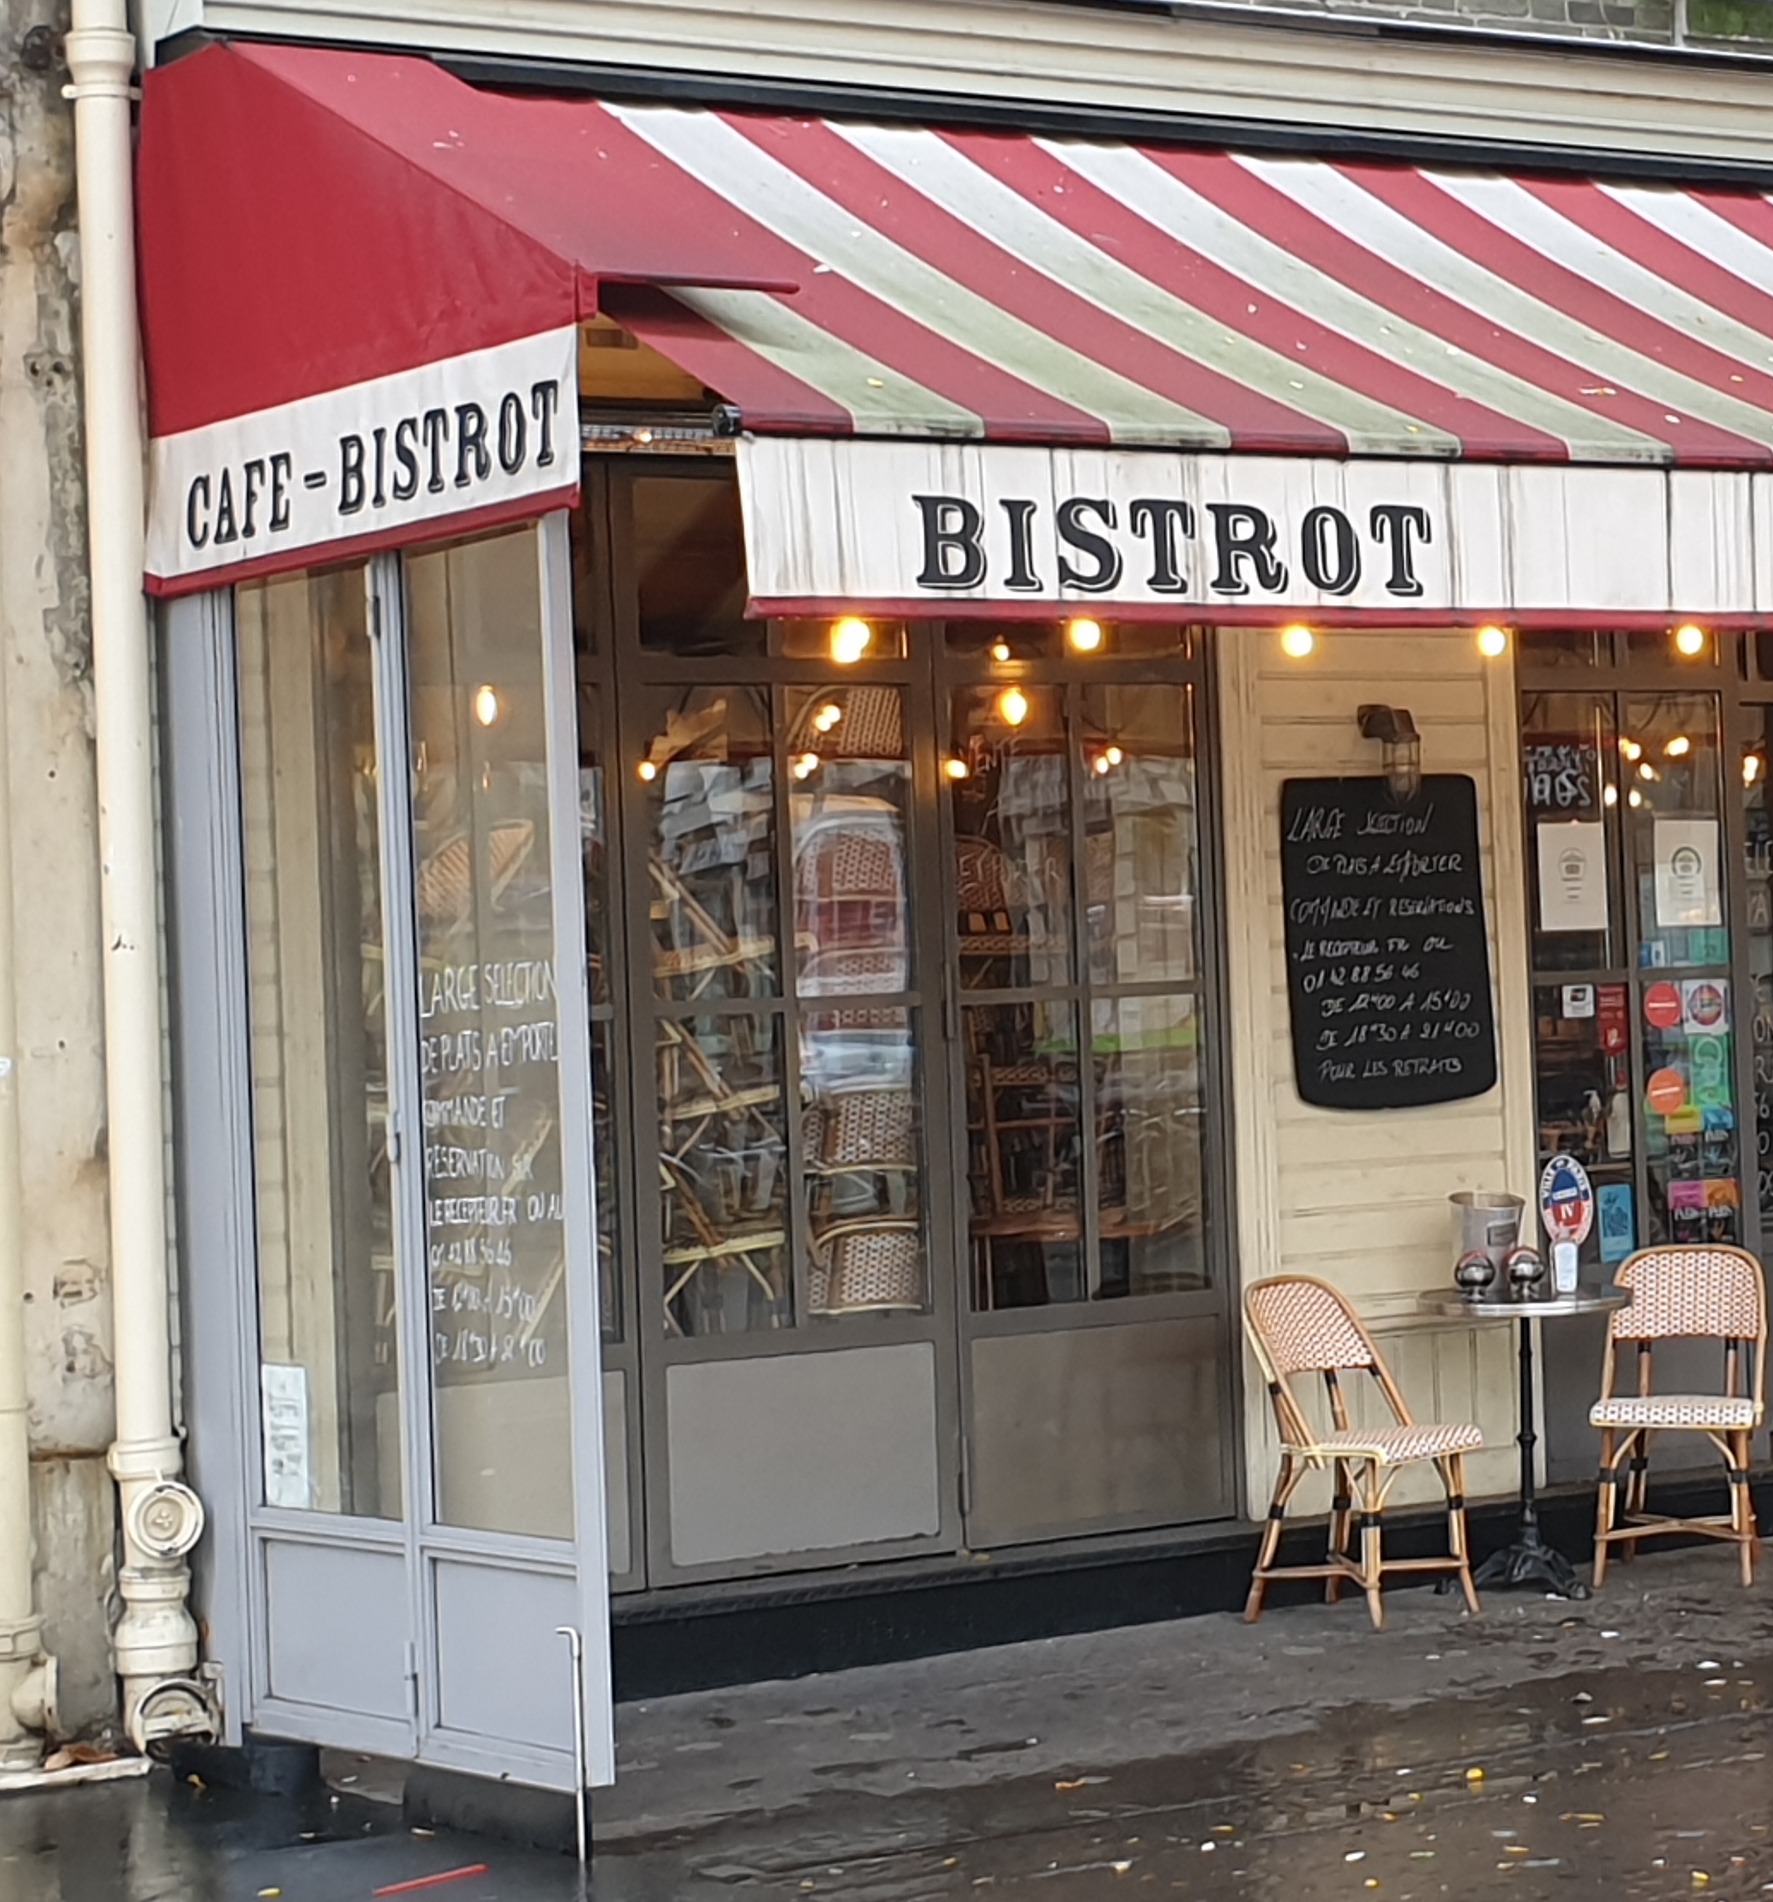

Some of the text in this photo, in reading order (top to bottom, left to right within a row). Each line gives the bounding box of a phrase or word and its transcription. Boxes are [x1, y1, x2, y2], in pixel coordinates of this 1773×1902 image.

[912, 495, 1431, 596] BISTROT
[420, 965, 480, 1018] LARGE
[440, 1030, 482, 1071] PLATS
[486, 1033, 499, 1068] A
[1362, 1059, 1388, 1078] LES
[491, 1096, 506, 1128] ET
